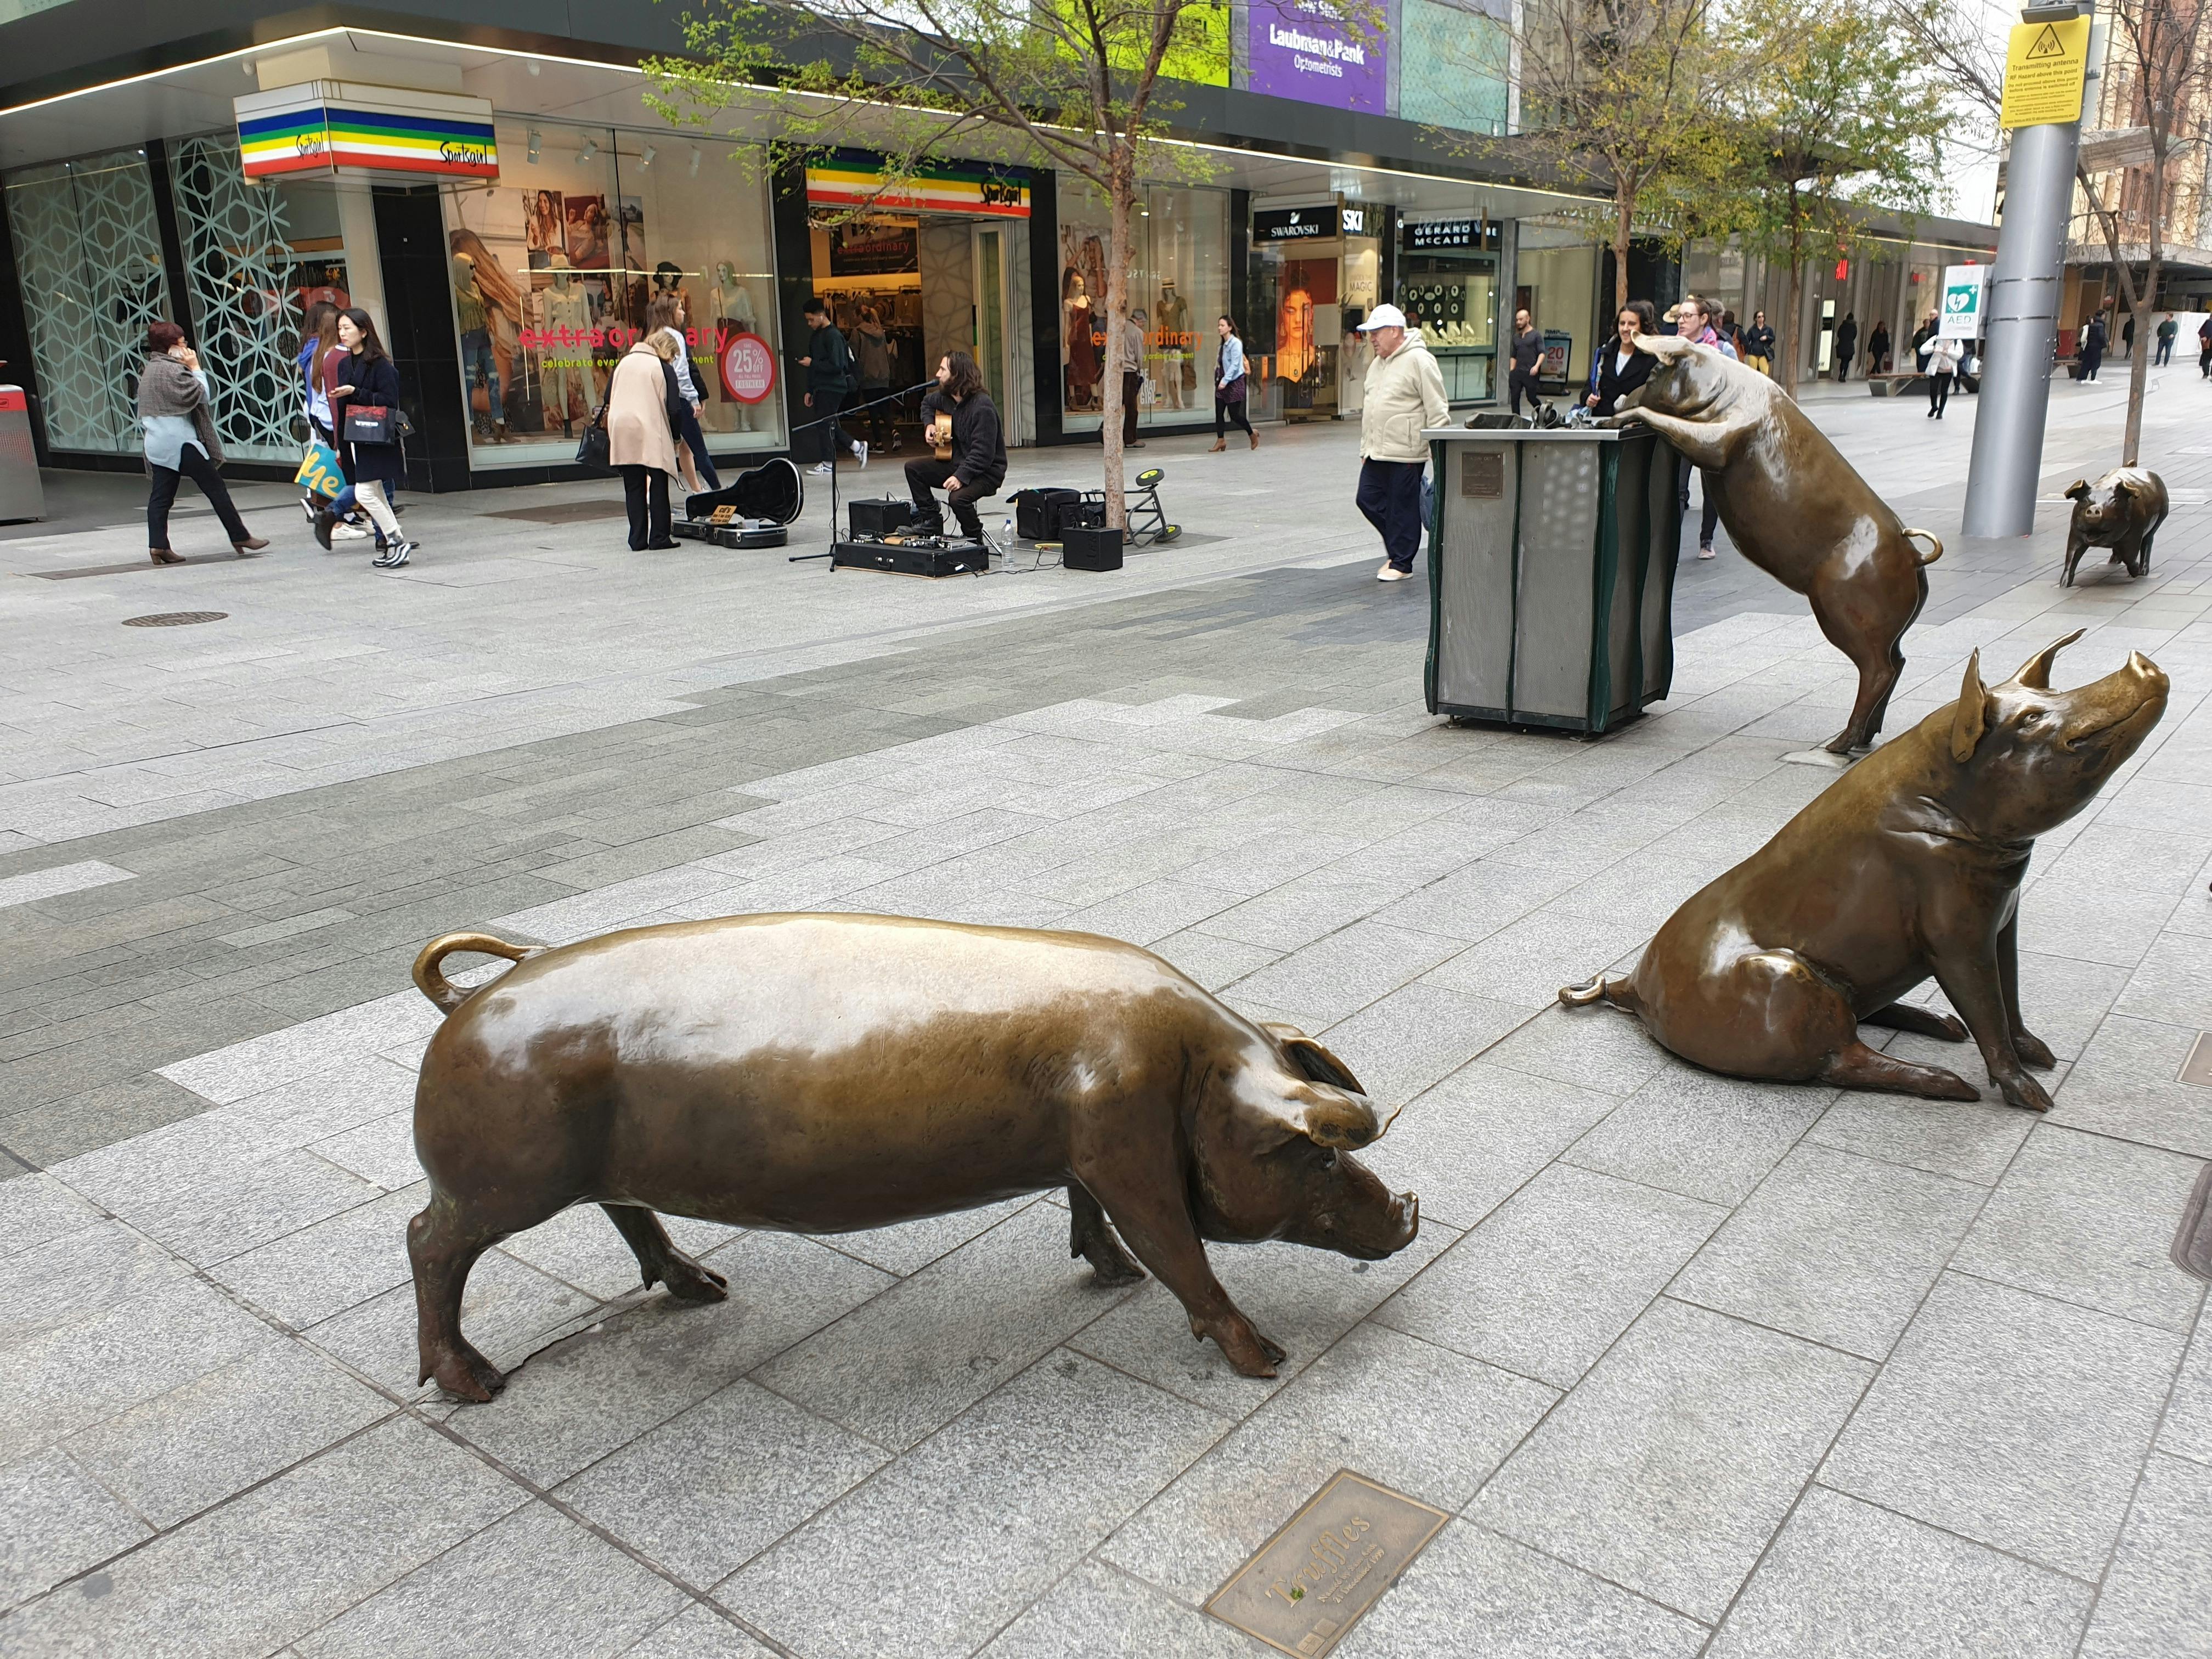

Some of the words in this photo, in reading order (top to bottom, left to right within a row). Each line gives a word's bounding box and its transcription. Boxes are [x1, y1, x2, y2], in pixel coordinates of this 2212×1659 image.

[1294, 54, 1343, 77] Optometrists
[2012, 61, 2051, 71] Transmitting
[2052, 59, 2079, 67] antenna
[296, 132, 325, 158] Sportsgirl
[439, 140, 488, 167] Sportsgirl
[1271, 223, 1319, 238] SWAROVSKI
[1414, 225, 1471, 236] GERARD
[1349, 281, 1372, 292] MAGIC
[1948, 315, 1972, 324] AED
[1548, 347, 1564, 360] 20
[541, 357, 593, 369] celebrate
[733, 349, 764, 373] 25%
[753, 364, 764, 373] OFF
[1139, 392, 1156, 405] GIRL
[1264, 1516, 1370, 1609] Truffles
[1340, 1560, 1373, 1595] December
